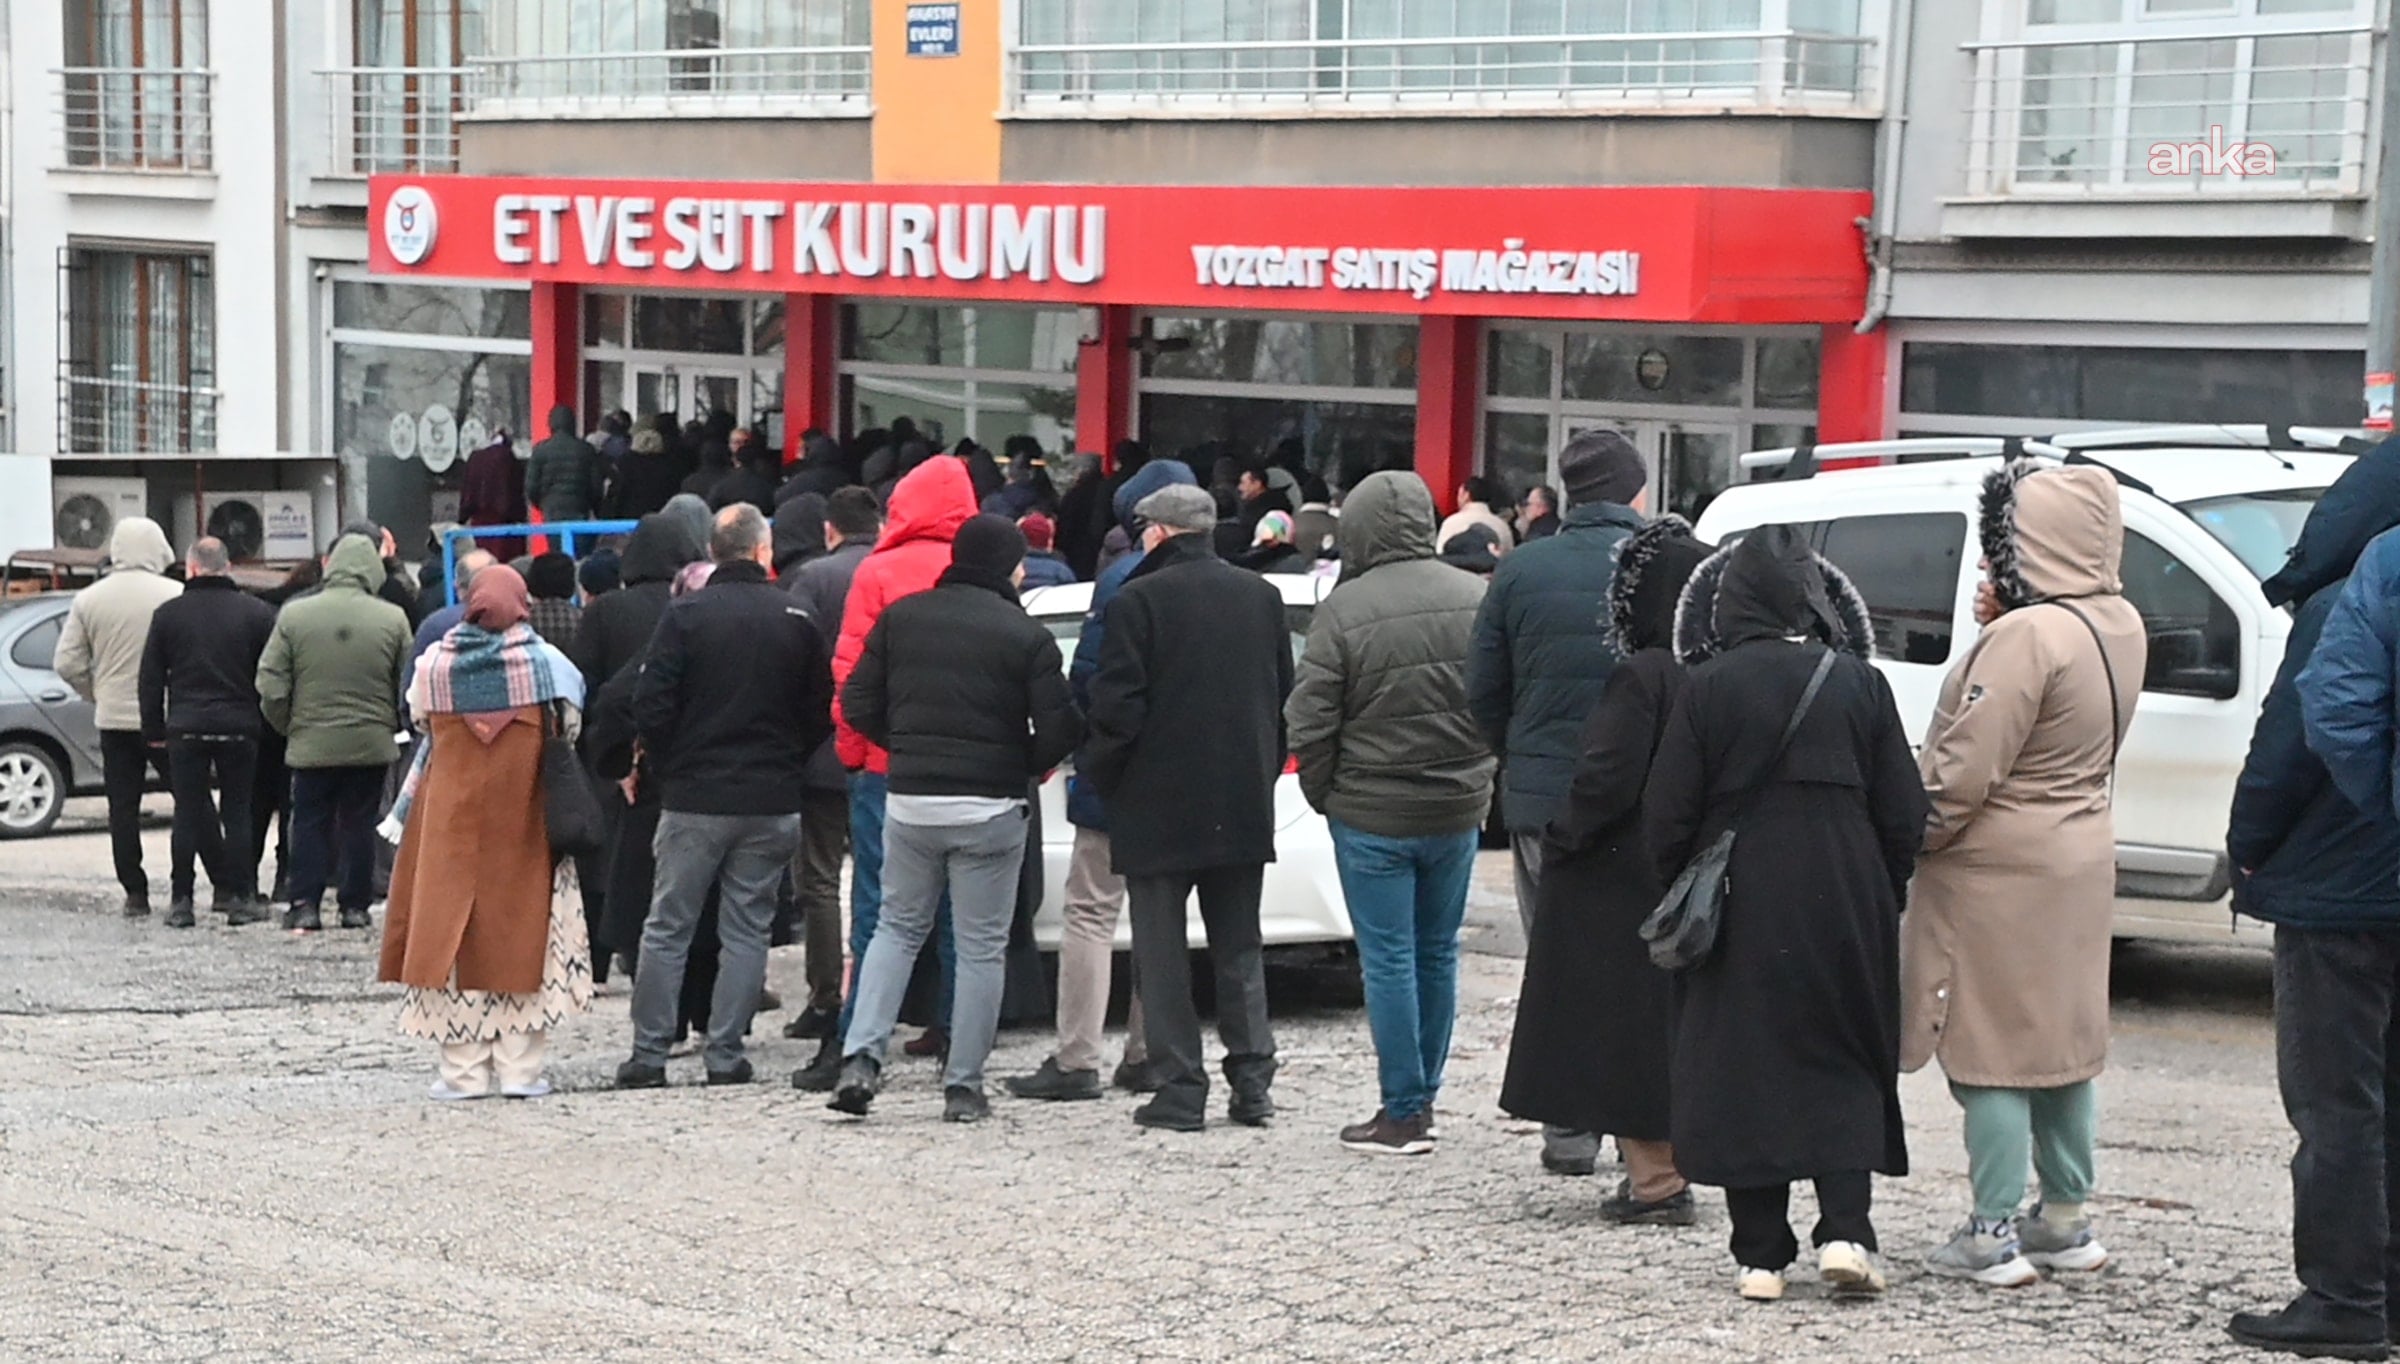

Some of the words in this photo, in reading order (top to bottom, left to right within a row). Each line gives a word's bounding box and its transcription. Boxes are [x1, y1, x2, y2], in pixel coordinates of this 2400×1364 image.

[494, 194, 570, 264] ET
[575, 195, 655, 267] VE
[663, 197, 785, 273] SÜT
[794, 201, 1106, 284] KURUMU
[1191, 244, 1329, 288] YOZGAT
[1331, 247, 1437, 300] SATIŞ
[1441, 238, 1639, 295] MAĞAZASI
